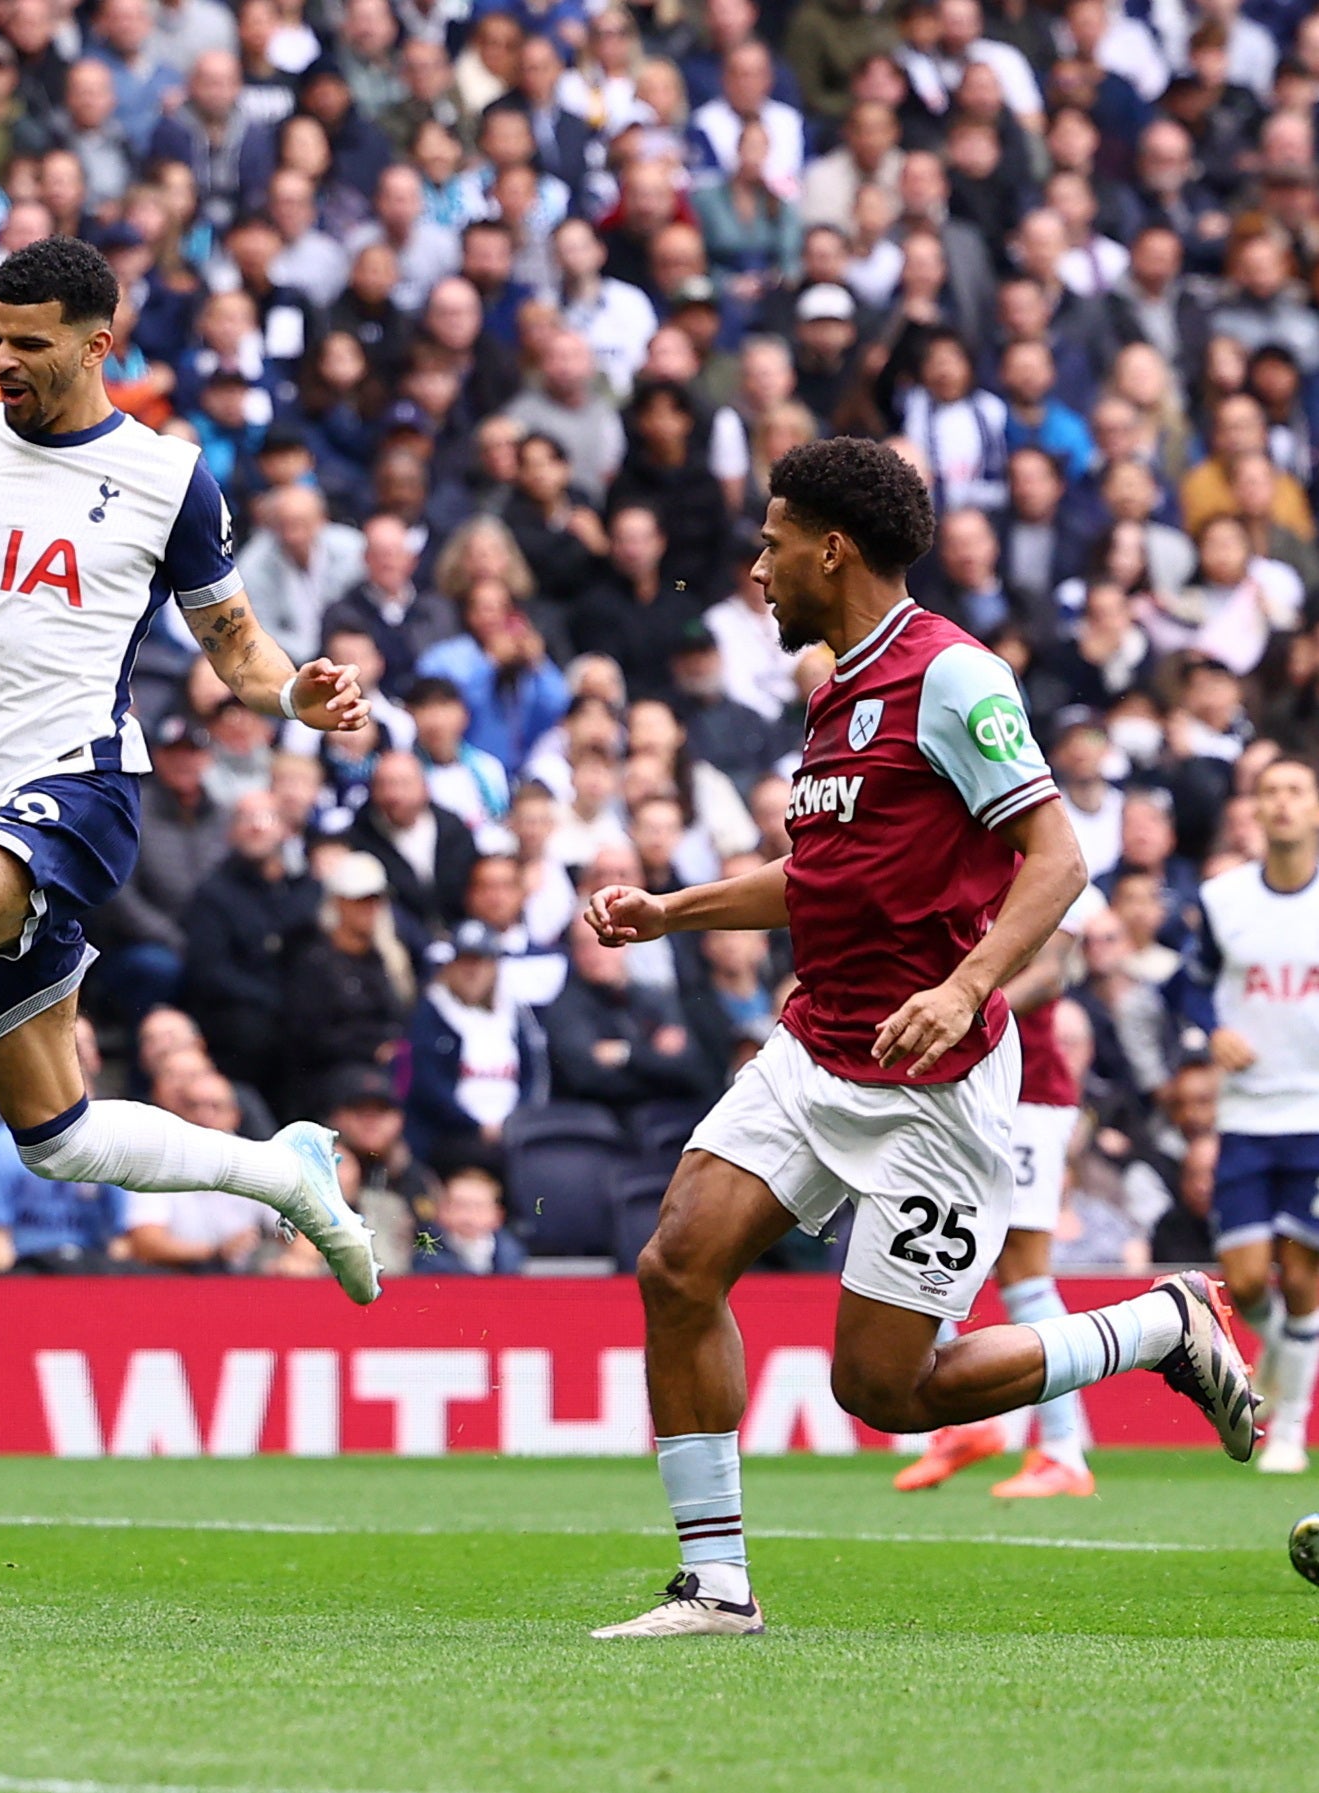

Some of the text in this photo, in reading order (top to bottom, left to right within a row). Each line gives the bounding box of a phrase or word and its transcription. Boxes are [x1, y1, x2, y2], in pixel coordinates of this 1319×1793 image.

[785, 775, 864, 823] etway
[1244, 964, 1319, 1002] AIA
[889, 1195, 977, 1271] 25
[920, 1284, 948, 1297] umbro
[34, 1346, 655, 1457] WITH
